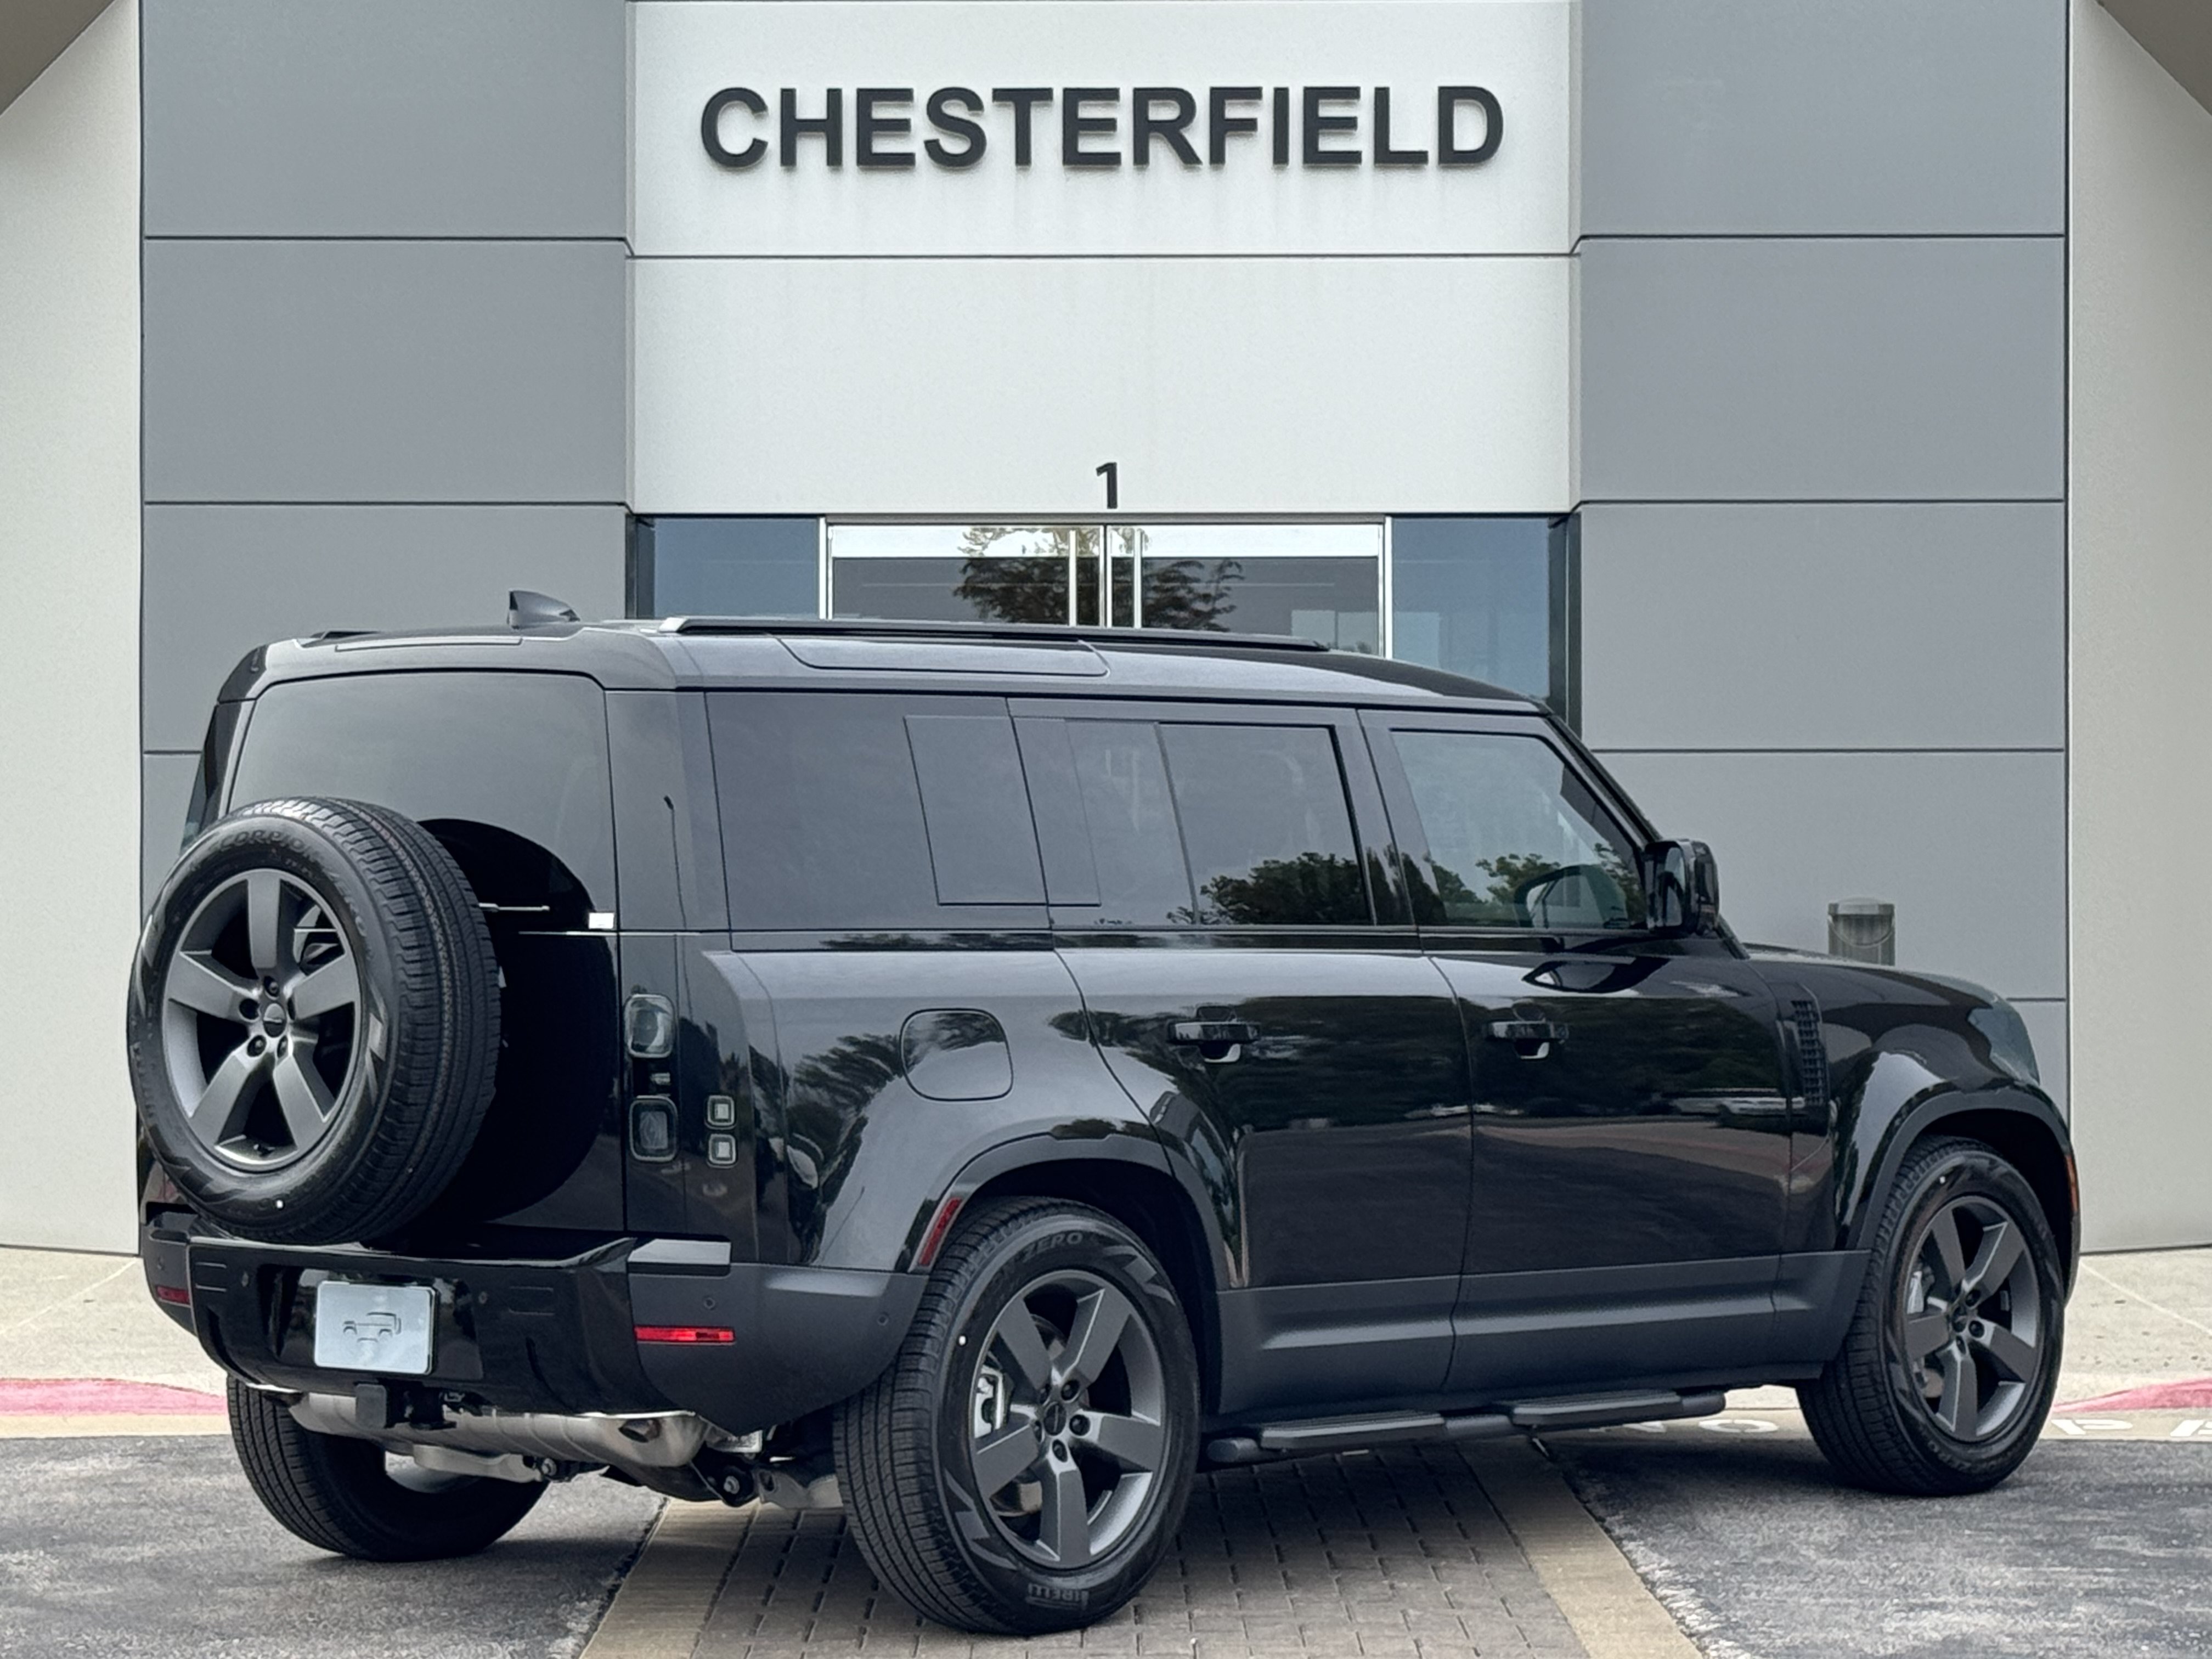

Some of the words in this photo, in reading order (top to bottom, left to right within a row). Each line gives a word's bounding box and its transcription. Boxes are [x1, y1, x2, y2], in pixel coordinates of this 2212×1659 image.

[701, 86, 1505, 169] CHESTERFIELD
[1096, 462, 1118, 509] 1
[1023, 1232, 1084, 1263] ZERO
[1026, 1583, 1089, 1610] PIRELLI
